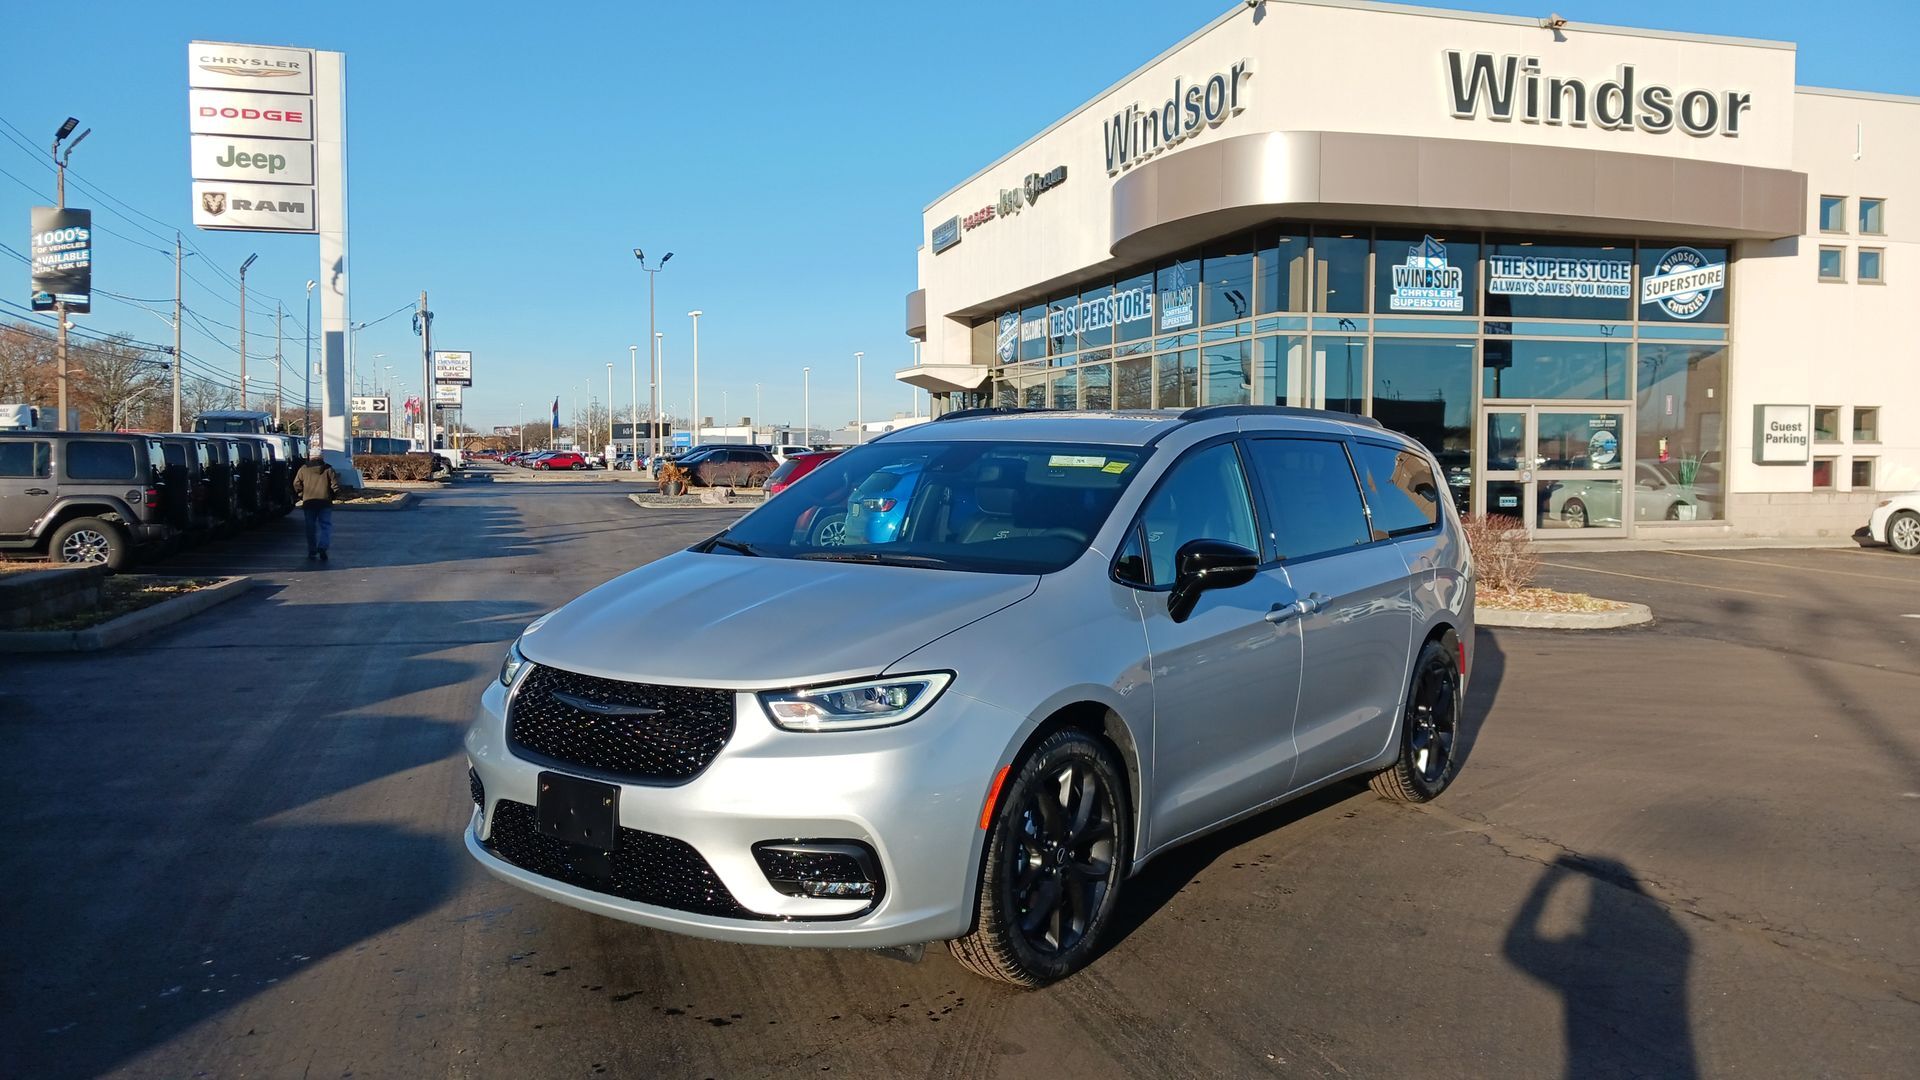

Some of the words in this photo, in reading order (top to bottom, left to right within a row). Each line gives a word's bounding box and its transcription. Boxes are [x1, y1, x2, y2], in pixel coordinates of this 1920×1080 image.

[200, 56, 300, 69] CHRYSLER
[1444, 48, 1752, 137] Windsor
[199, 106, 303, 123] DODGE
[1103, 57, 1252, 175] Windsor
[216, 145, 286, 174] Jeep
[1034, 165, 1067, 192] RAM
[232, 199, 305, 213] RAM
[35, 227, 90, 246] 1000's
[48, 242, 87, 252] VEHICLES
[37, 250, 90, 264] AVAILABLE
[1661, 252, 1700, 272] WINDSOR
[35, 266, 56, 274] JUST
[57, 262, 75, 270] ASK
[76, 260, 89, 268] US
[1491, 256, 1523, 277] THE
[1525, 258, 1631, 281] SUPERSTORE
[1395, 268, 1460, 289] WINDSOR
[1646, 270, 1722, 297] SUPERSTORE
[1400, 288, 1454, 298] CHRYSLER
[1491, 280, 1536, 294] ALWAYS
[1537, 281, 1573, 295] SAVES
[1574, 283, 1596, 296] YOU
[1597, 283, 1630, 298] MORE!
[1049, 311, 1065, 338] THE
[1065, 285, 1153, 336] SUPERSTORE
[1393, 298, 1461, 308] SUPERSTORE
[1667, 293, 1706, 314] CHRYSLER
[1770, 421, 1803, 432] Guest
[1765, 433, 1807, 446] Parking
